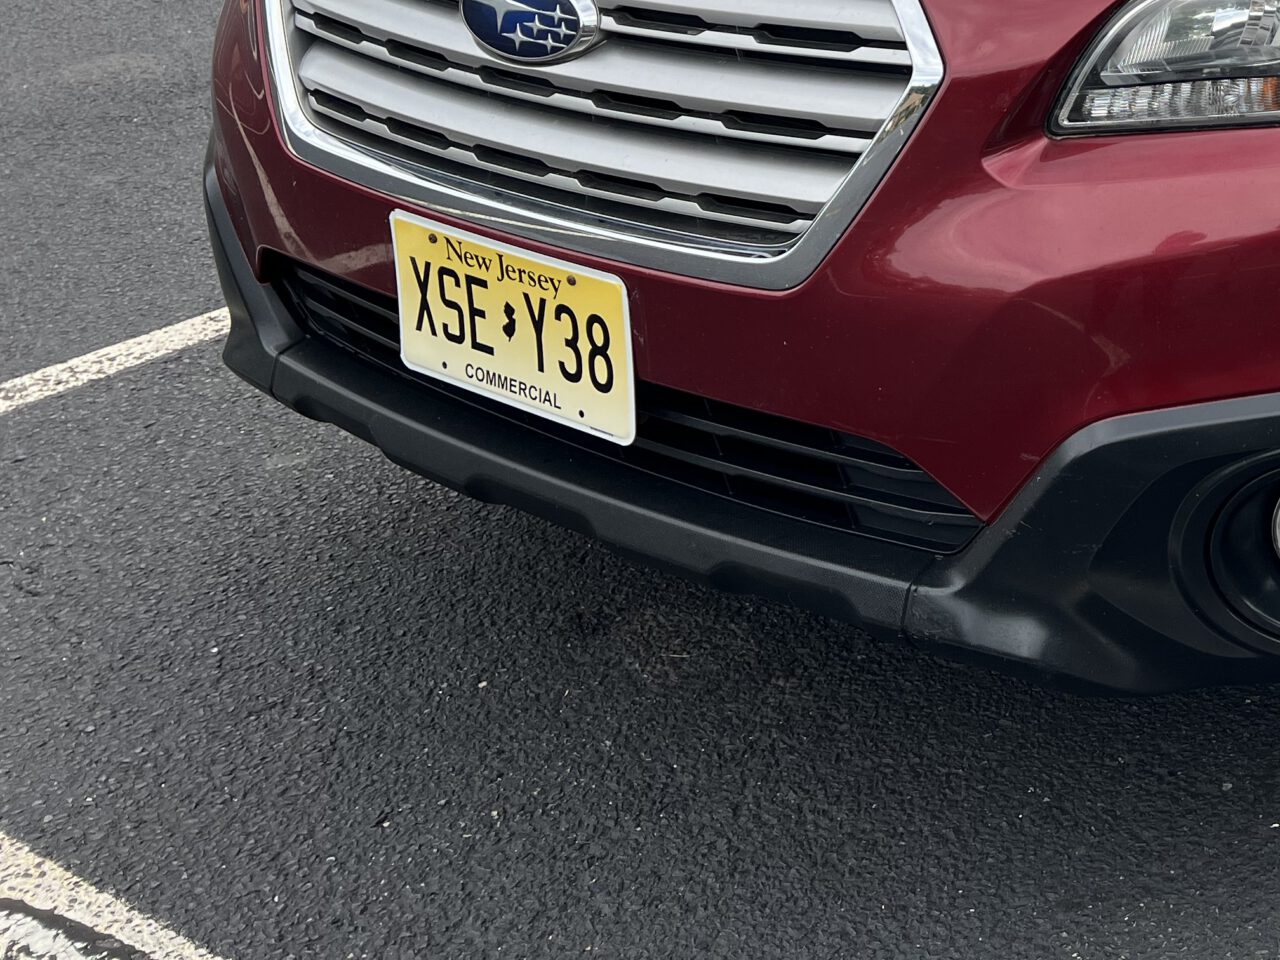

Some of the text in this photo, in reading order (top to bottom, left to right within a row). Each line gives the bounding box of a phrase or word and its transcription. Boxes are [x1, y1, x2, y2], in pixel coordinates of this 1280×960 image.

[444, 236, 562, 300] New Jersey
[409, 256, 614, 394] XSE Y38
[465, 363, 562, 410] COMMERCIAL
